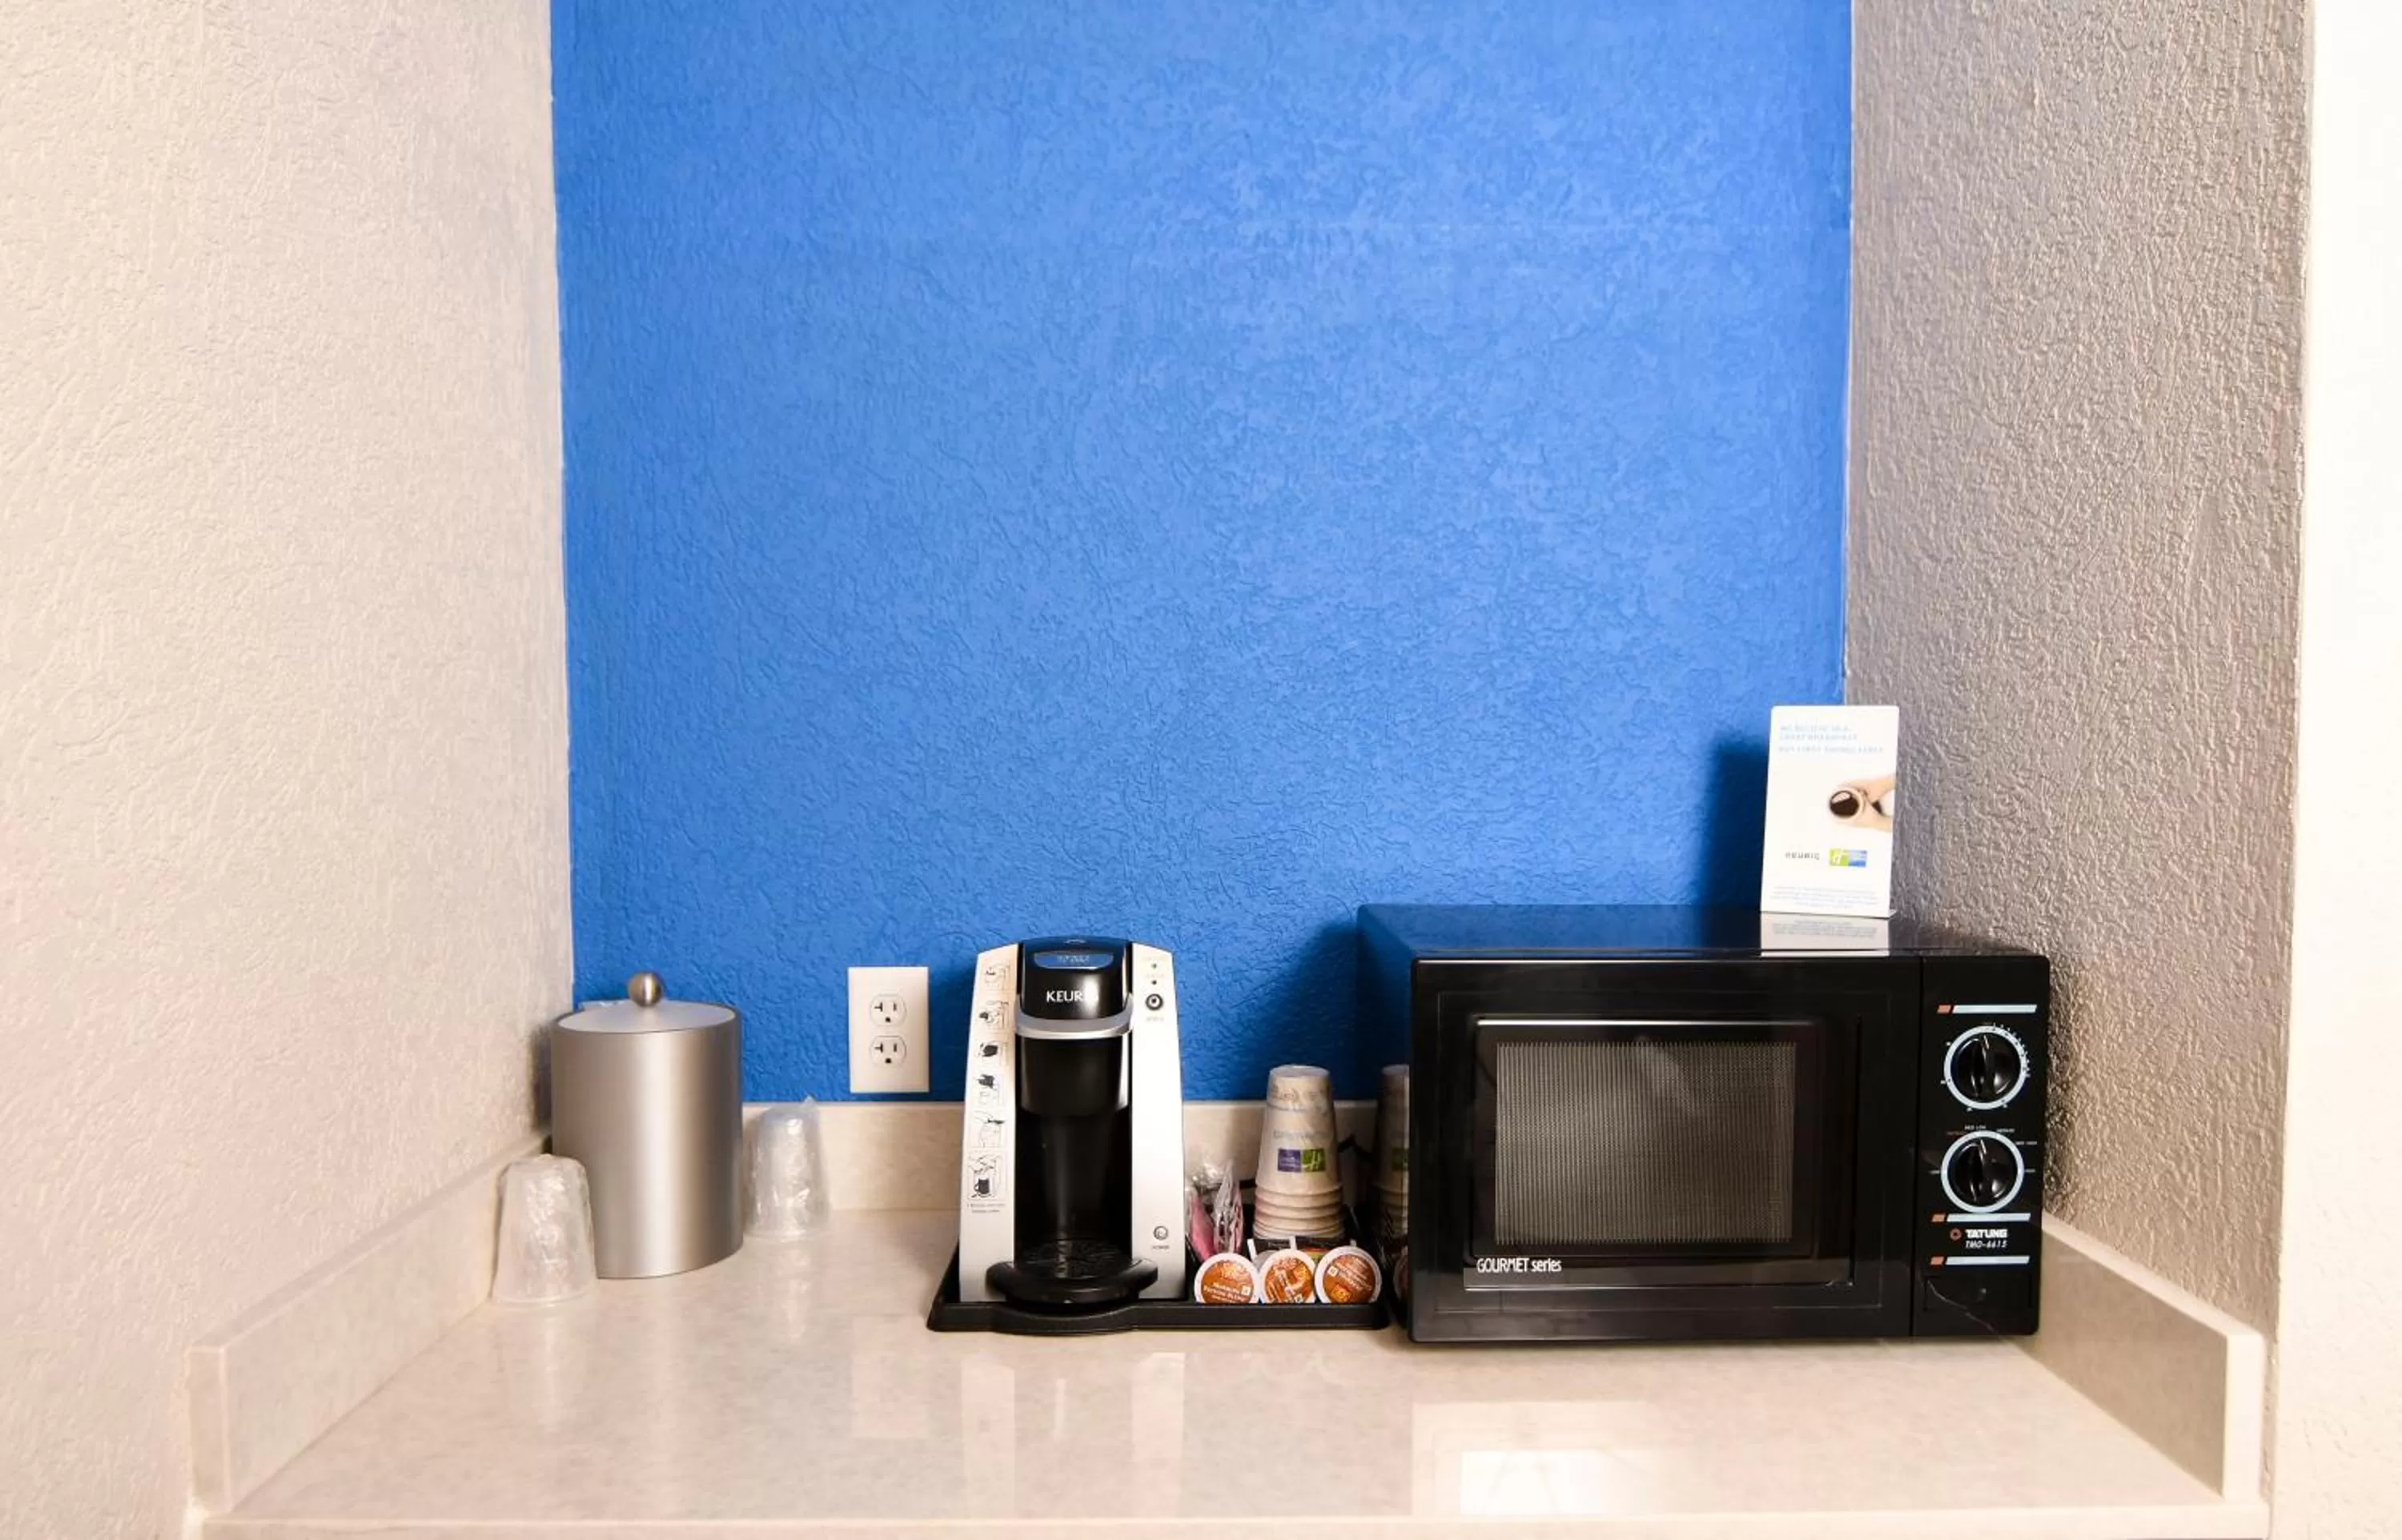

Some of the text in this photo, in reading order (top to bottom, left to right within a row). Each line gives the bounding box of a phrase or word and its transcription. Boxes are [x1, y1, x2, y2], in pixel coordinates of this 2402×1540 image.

[1046, 990, 1099, 1002] KEUR
[1965, 1229, 2008, 1238] TATUNG
[1477, 1257, 1562, 1273] GOURMET series
